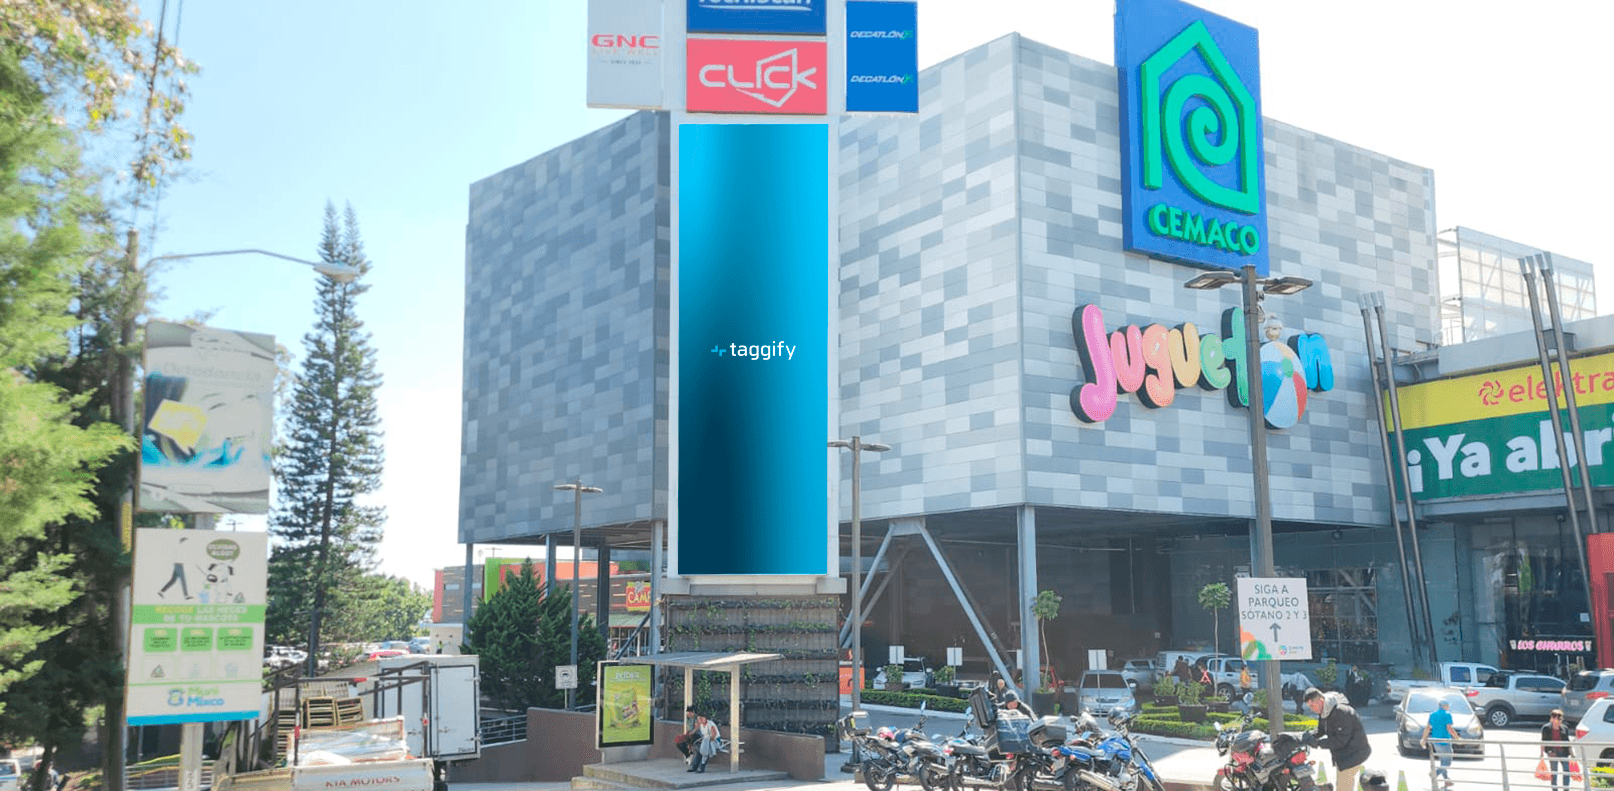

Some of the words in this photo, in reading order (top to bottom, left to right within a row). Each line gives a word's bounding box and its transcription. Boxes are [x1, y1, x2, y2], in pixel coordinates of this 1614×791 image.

[591, 34, 660, 48] GNC
[699, 56, 817, 96] CLICK
[1149, 203, 1260, 256] CEMACO
[730, 341, 796, 360] taggify
[1506, 412, 1614, 473] abr
[1254, 584, 1279, 594] SIGA
[1281, 585, 1289, 594] A
[1248, 597, 1299, 608] PARQUEO
[1241, 608, 1283, 620] SÓTANO
[1286, 611, 1291, 620] 2
[1293, 611, 1299, 620] Y
[1302, 611, 1307, 620] 3
[325, 779, 347, 787] KIA
[350, 776, 400, 786] MOTORS
